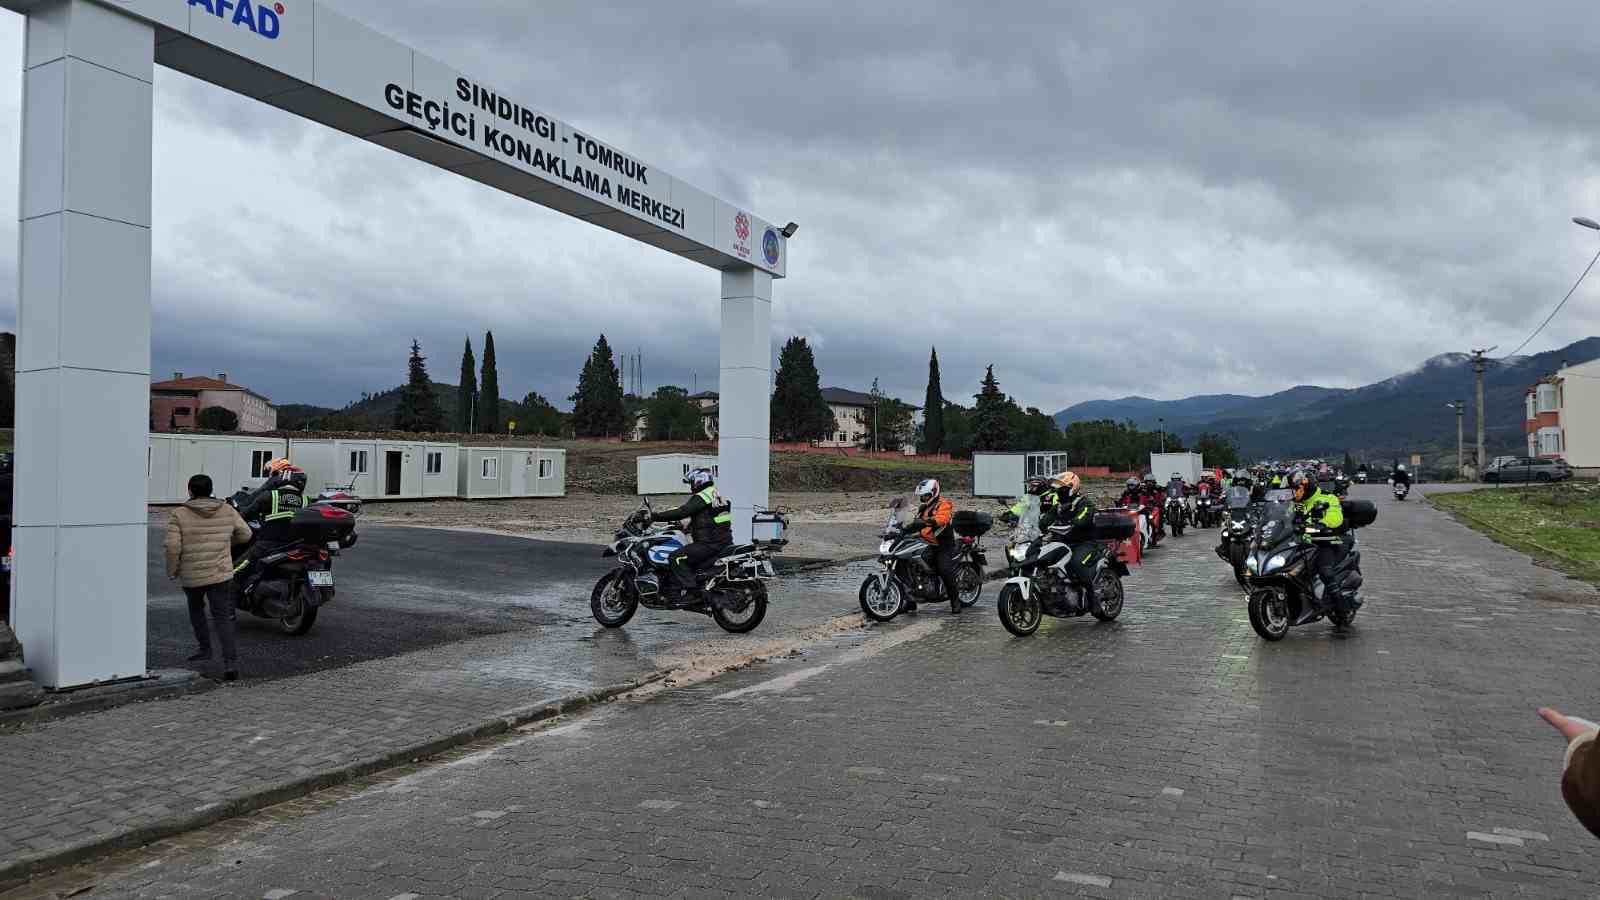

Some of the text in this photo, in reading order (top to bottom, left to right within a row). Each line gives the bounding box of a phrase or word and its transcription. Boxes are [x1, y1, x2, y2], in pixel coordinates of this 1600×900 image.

[384, 83, 685, 229] GEÇİCİ KONAKLAMA MERKEZİ
[456, 77, 555, 142] SINDIRGI
[573, 132, 648, 185] TOMRUK
